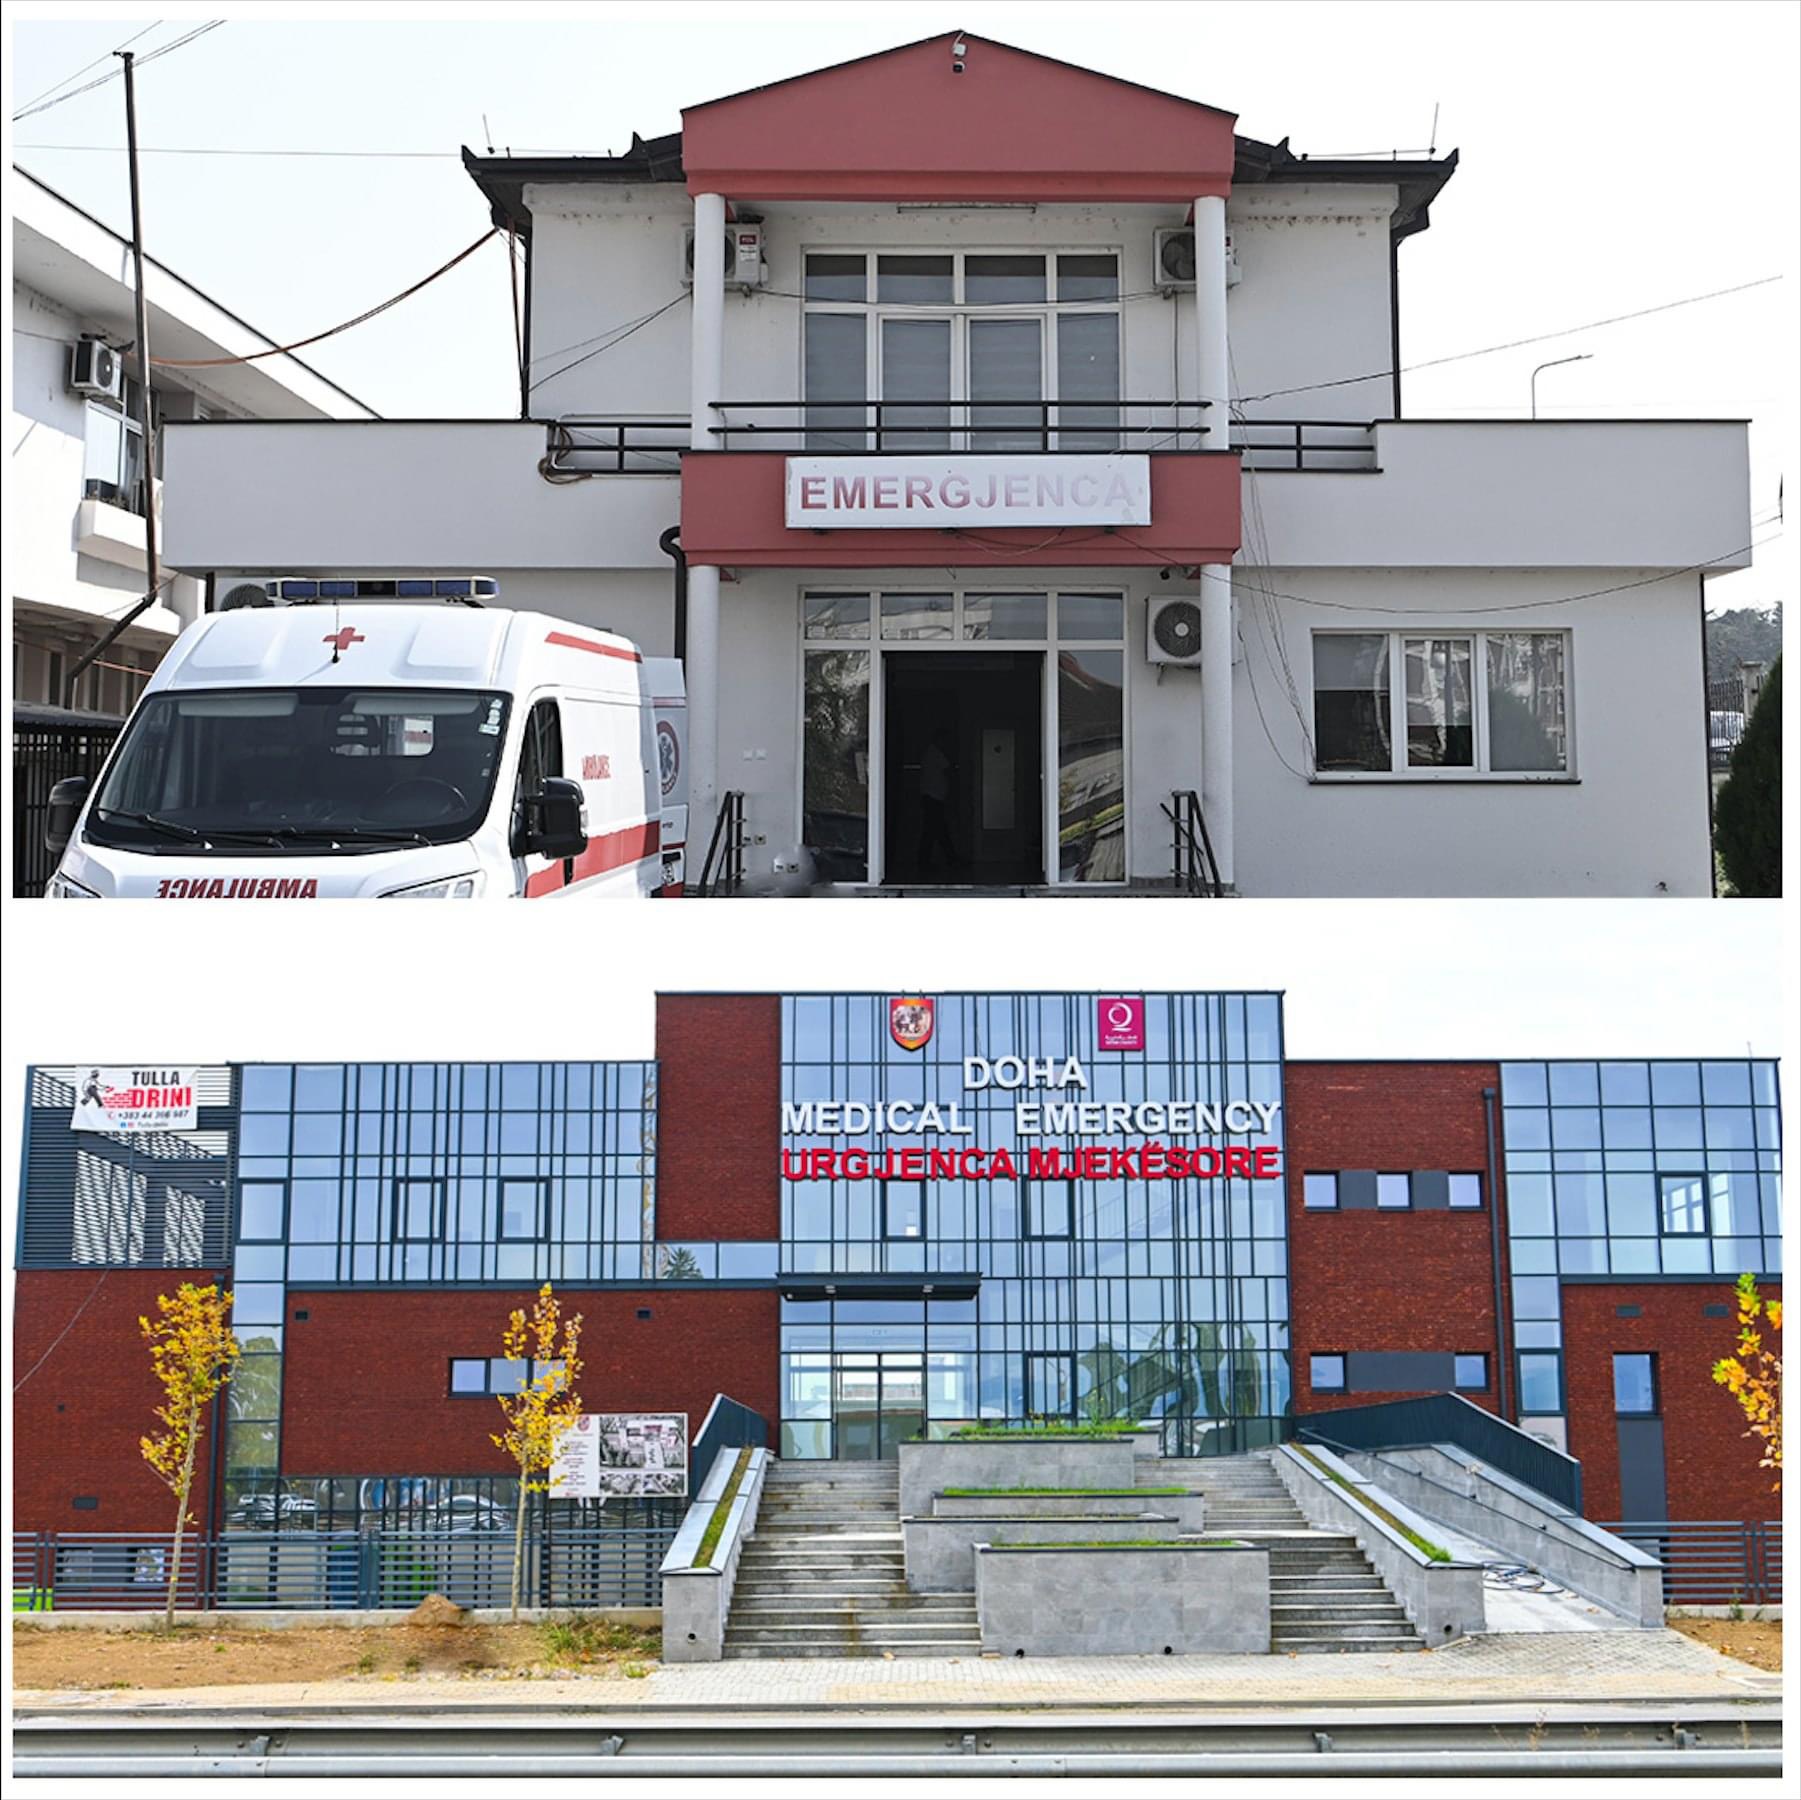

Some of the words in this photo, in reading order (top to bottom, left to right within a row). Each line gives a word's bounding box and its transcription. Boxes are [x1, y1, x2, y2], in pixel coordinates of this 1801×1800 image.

[800, 475, 1136, 510] EMERGJENCA
[132, 1071, 180, 1085] TULLA
[963, 1056, 1088, 1090] DOHA
[131, 1087, 192, 1108] DRINI
[781, 1101, 974, 1136] MEDICAL
[1015, 1101, 1282, 1136] EMERGENCY
[782, 1147, 1018, 1181] URGJENCA
[1028, 1140, 1281, 1180] MJEKËSORE
